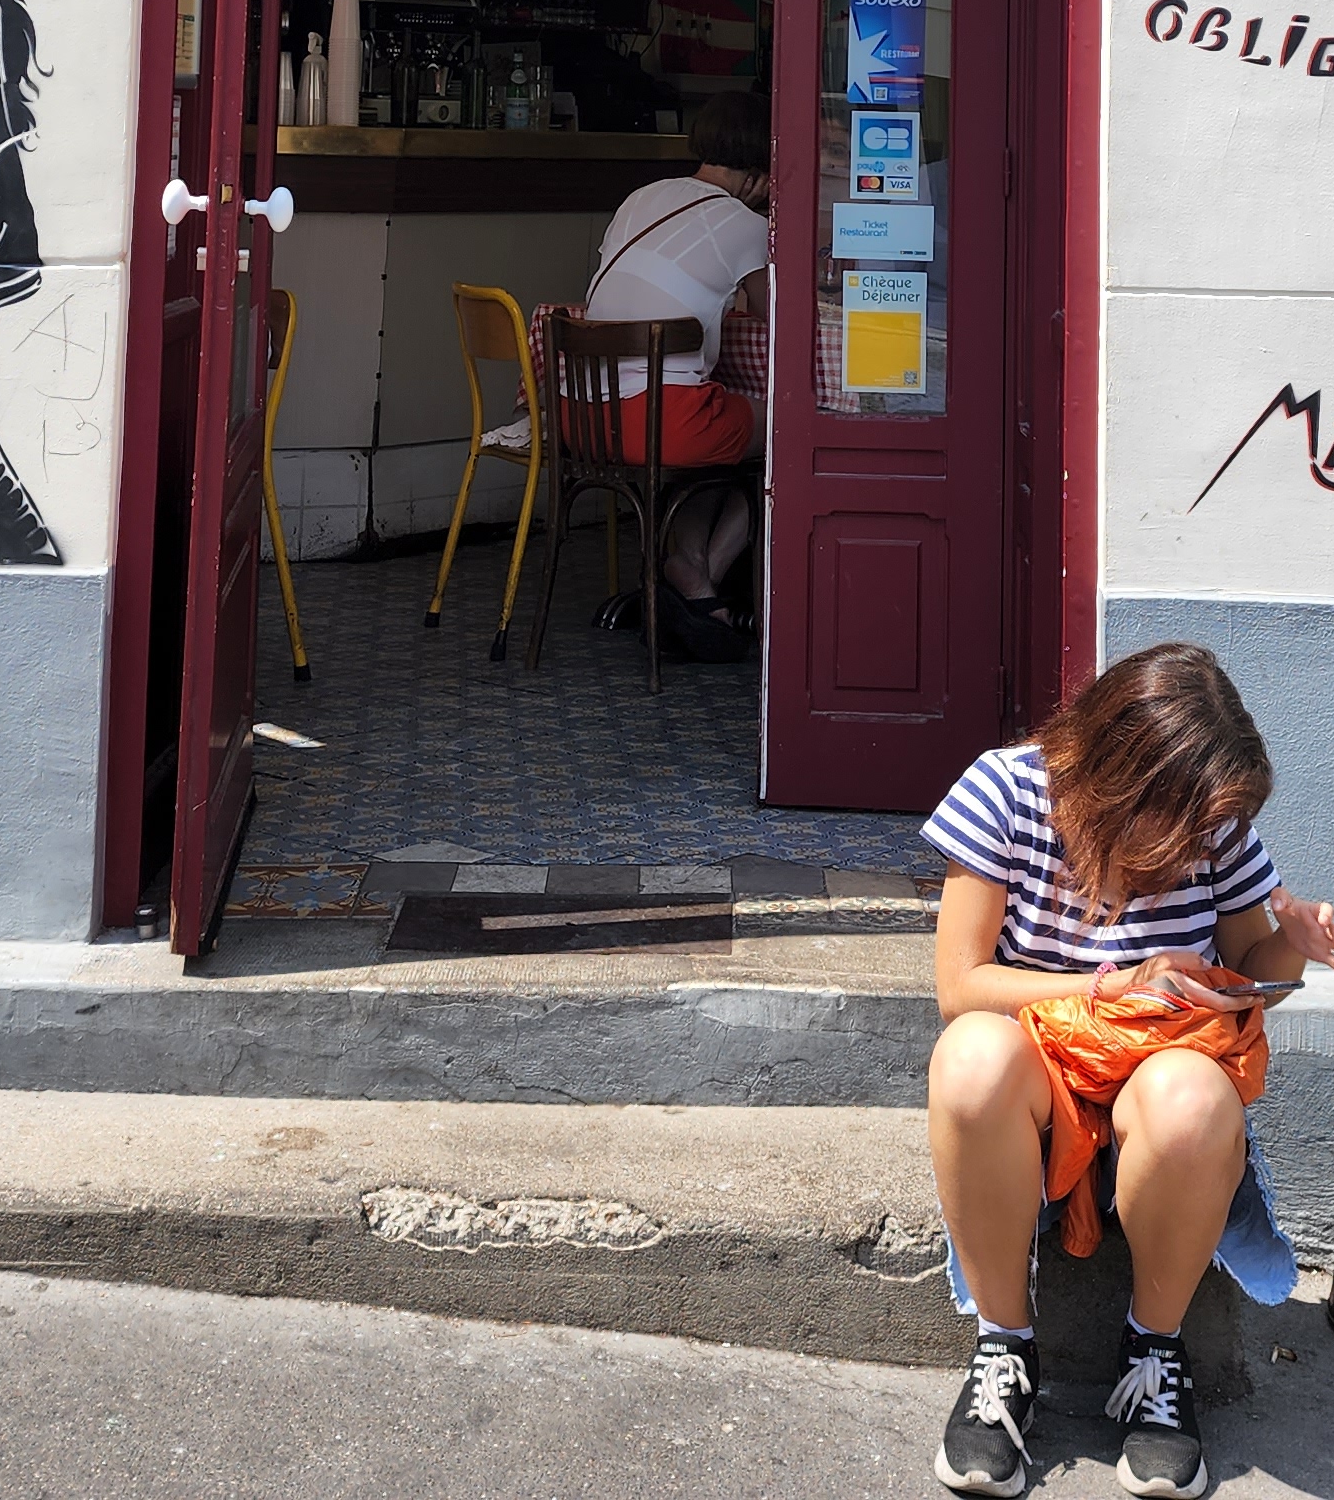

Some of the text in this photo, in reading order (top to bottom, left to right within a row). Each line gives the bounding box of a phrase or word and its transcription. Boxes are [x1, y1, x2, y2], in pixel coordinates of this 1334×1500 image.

[862, 126, 910, 150] CB
[889, 180, 912, 190] VISA
[862, 220, 889, 229] Ticket
[839, 227, 889, 237] Restaurant
[862, 275, 912, 290] Chèque
[862, 289, 921, 304] Déjeuner
